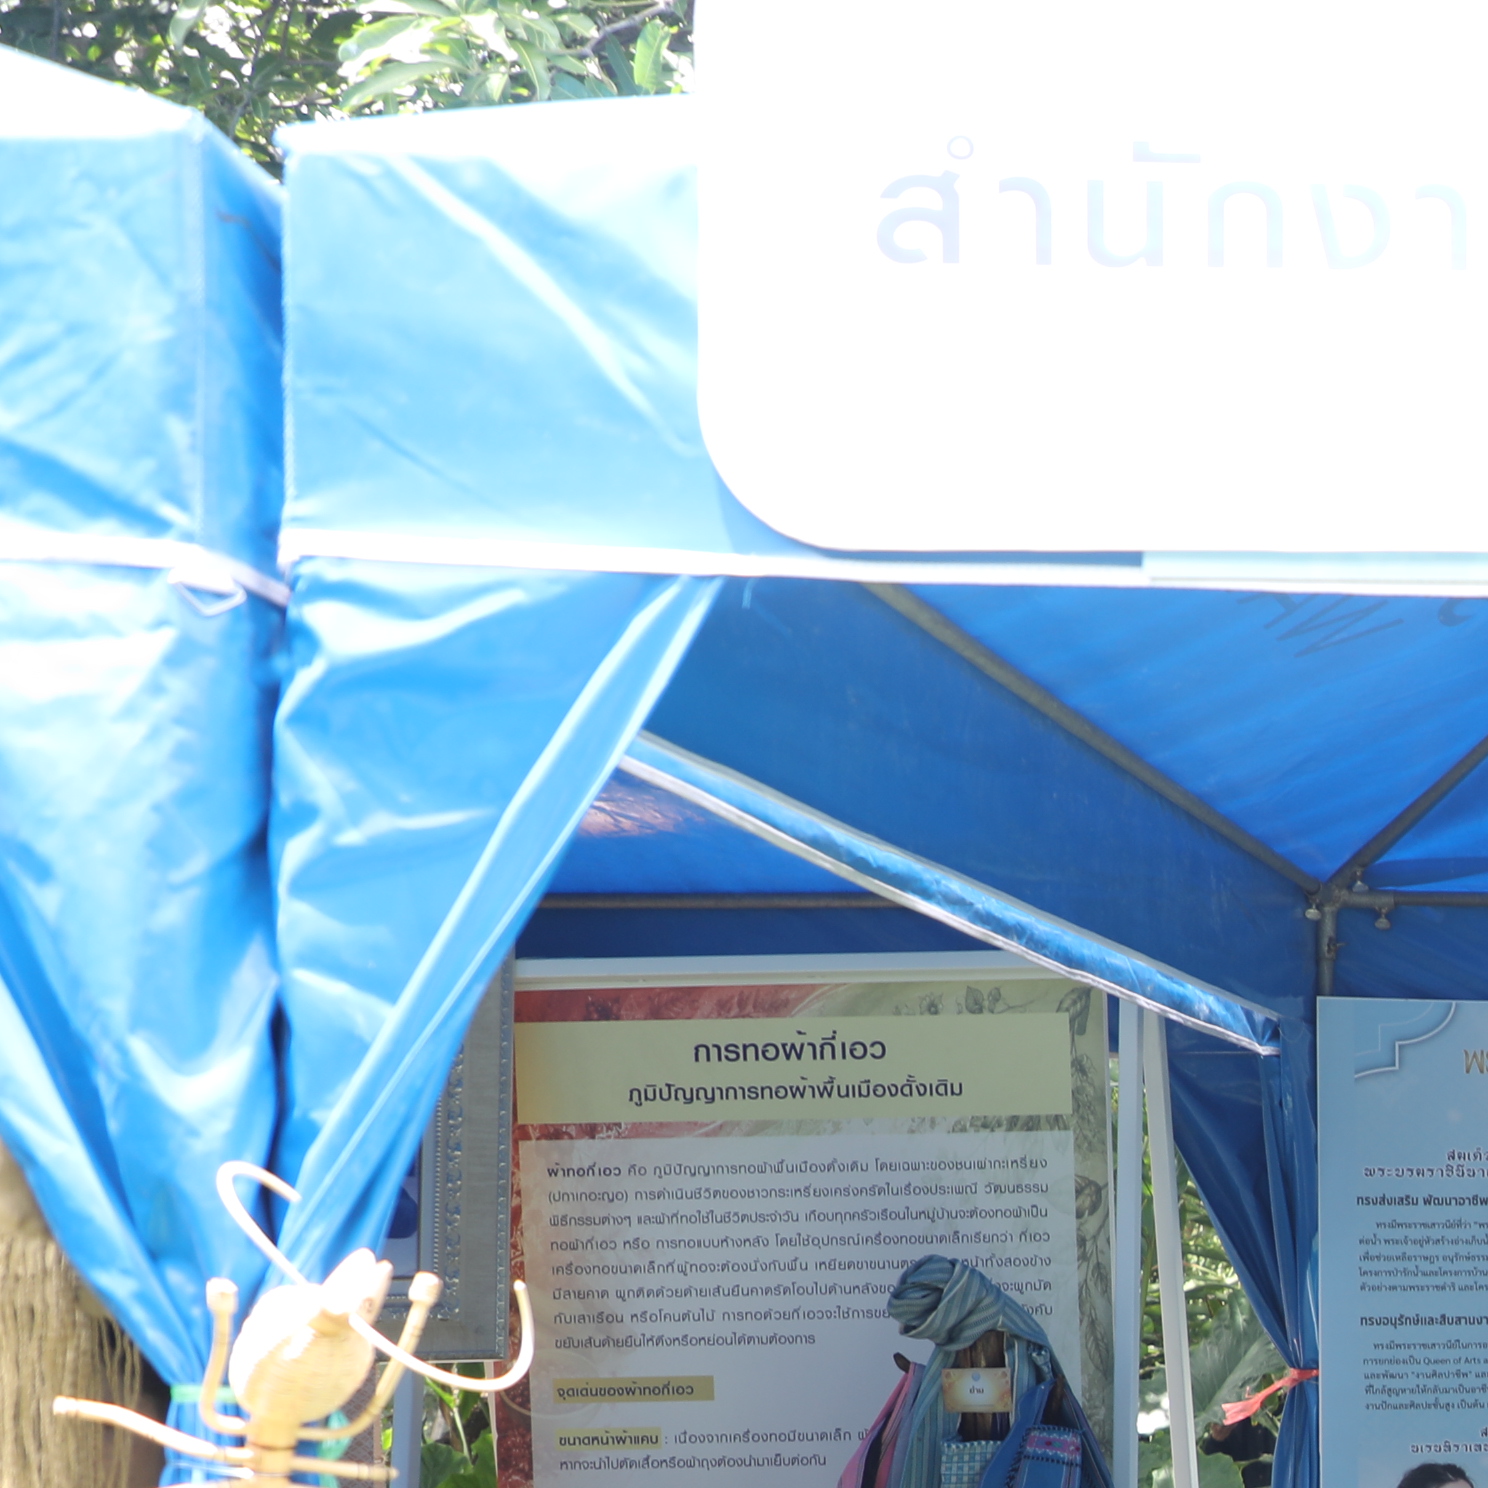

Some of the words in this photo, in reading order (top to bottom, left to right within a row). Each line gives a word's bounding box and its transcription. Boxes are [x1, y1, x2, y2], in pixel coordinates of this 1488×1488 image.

[694, 1030, 887, 1063] การทอผ้ากี่เอว
[628, 1075, 963, 1106] ภูมิปัญญาการทอผ้าพื้นเมืองดั้งเดิม
[547, 1163, 621, 1178] ผ้าทอกี่เอว
[628, 1163, 647, 1177] คือ
[875, 1155, 1047, 1171] โดยเฉพาะของชนเผ่ากะเหรี่ยง
[549, 1189, 628, 1203] (ปกาเกอะญอ)
[985, 1181, 1048, 1194] วัฒนธรรม
[1357, 1193, 1418, 1207] ทรงส่งเสริม
[1423, 1192, 1488, 1207] พัฒนาอาชีพ
[550, 1211, 631, 1227] พิธีกรรมต่างๆ
[551, 1236, 617, 1251] ทอผ้ากี่เอว
[623, 1236, 650, 1250] หรือ
[1019, 1229, 1050, 1243] กี่เอว
[553, 1287, 609, 1300] มีสายคาด
[554, 1310, 623, 1325] กับเสาเรือน
[630, 1308, 714, 1323] หรือโคนต้นไม้
[1424, 1357, 1451, 1365] Queen
[1454, 1356, 1462, 1365] of
[1464, 1356, 1481, 1365] Arts
[557, 1381, 694, 1400] จุดเด่นของผ้าทอกี่เอว
[559, 1430, 659, 1447] ขนาดหน้าผ้าแคบ
[674, 1429, 851, 1445] เนื่องจากเครื่องทอมีขนาดเล็ก
